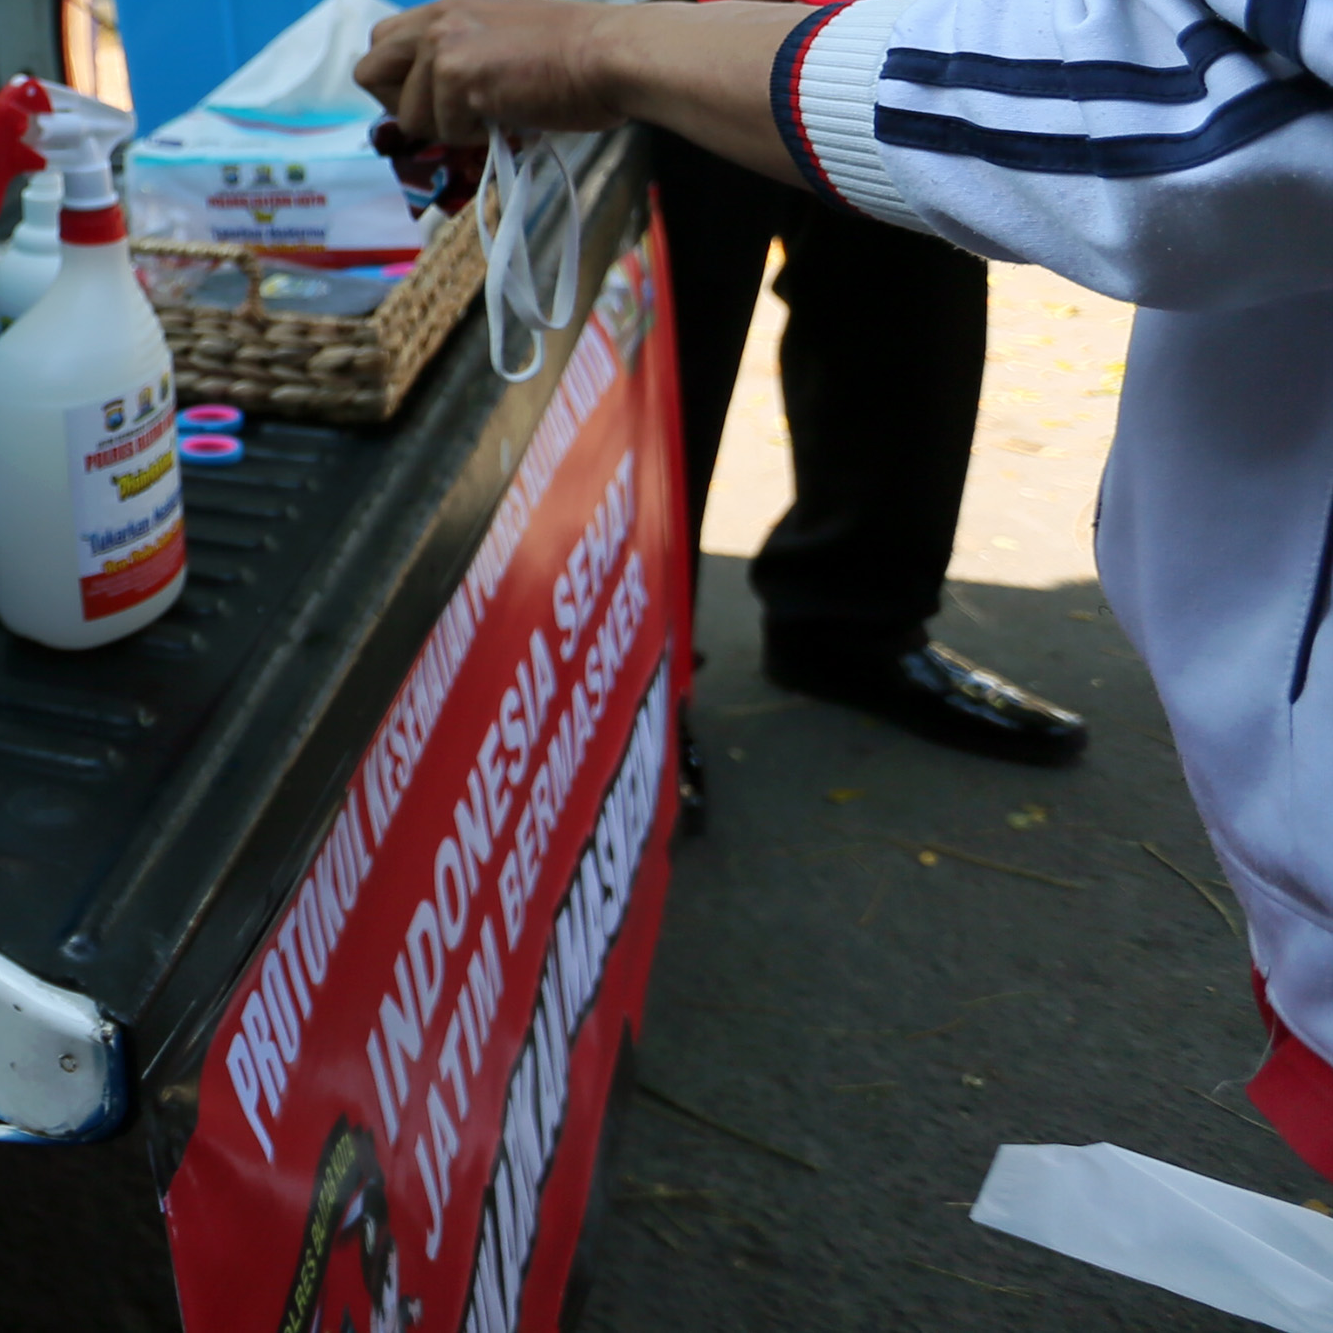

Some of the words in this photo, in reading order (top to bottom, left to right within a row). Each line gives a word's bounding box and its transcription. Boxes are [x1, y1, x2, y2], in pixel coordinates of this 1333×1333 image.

[225, 787, 373, 1164] PROTOKOL
[363, 577, 476, 846] KESEHATAN
[366, 627, 558, 1147] INDONESIA
[553, 447, 634, 662] SEHAT
[414, 915, 504, 1262] JATIM
[497, 550, 650, 952] BERMASKER
